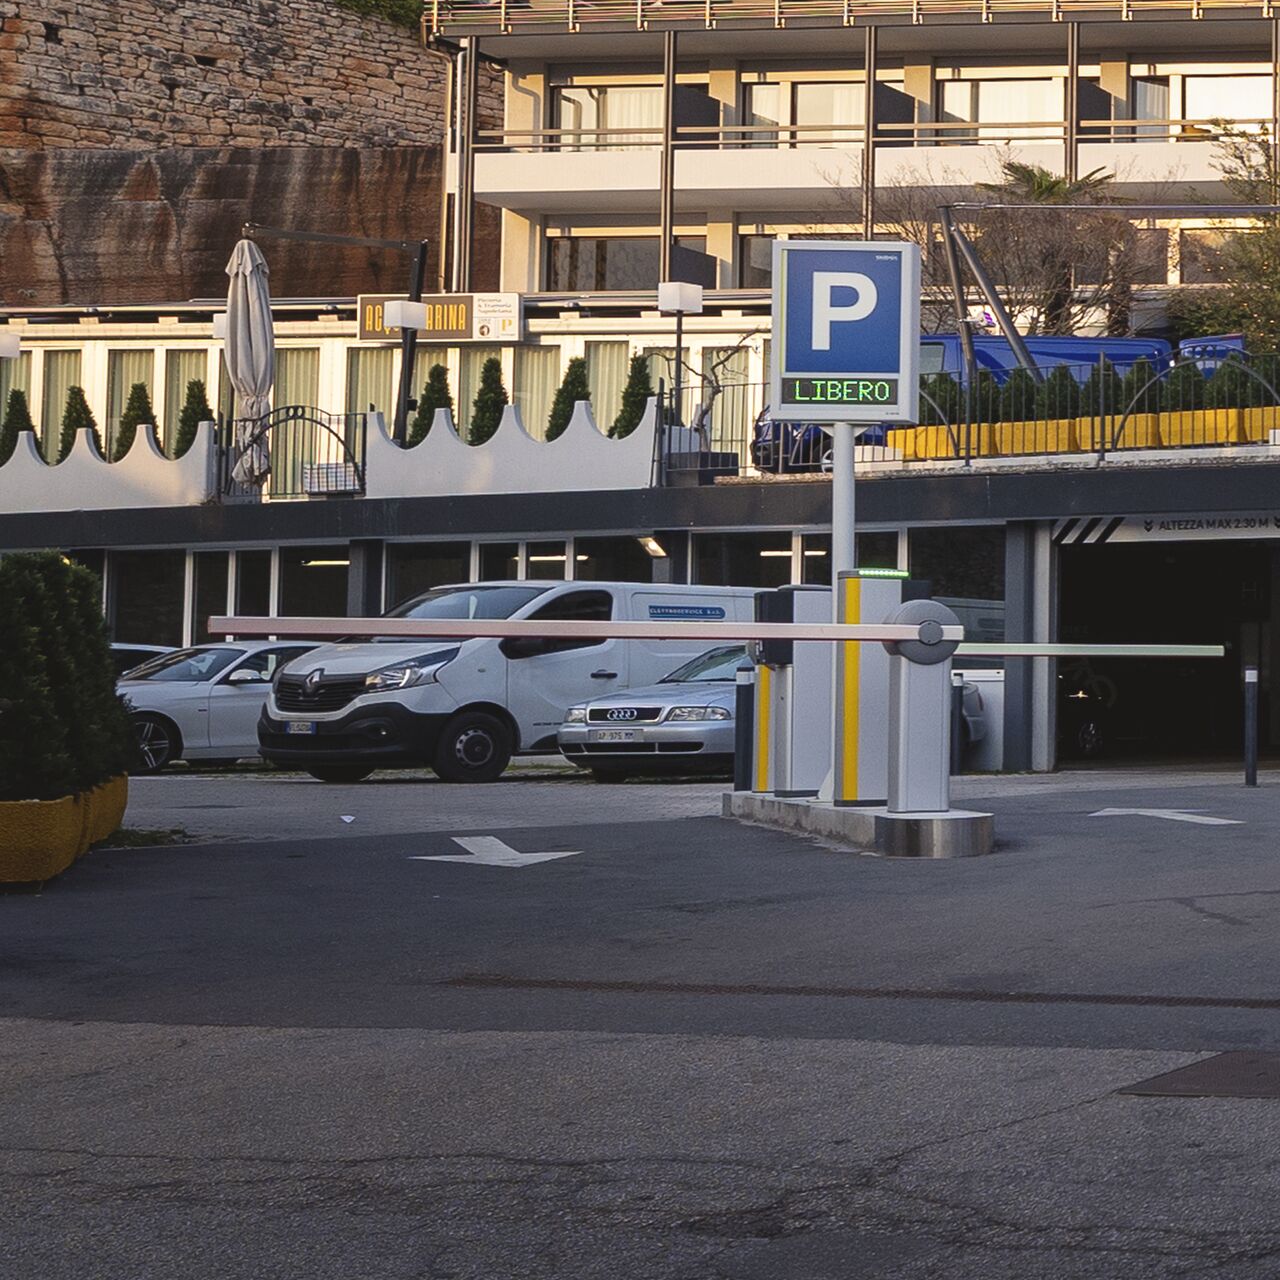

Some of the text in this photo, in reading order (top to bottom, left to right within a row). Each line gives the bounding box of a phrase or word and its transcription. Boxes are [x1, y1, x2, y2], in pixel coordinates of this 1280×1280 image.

[365, 303, 466, 334] ACARINA
[811, 271, 878, 351] P
[794, 380, 890, 402] LIBERO
[1160, 519, 1204, 531] ALTEZZA
[1206, 519, 1232, 530] MAX
[1258, 518, 1269, 528] M
